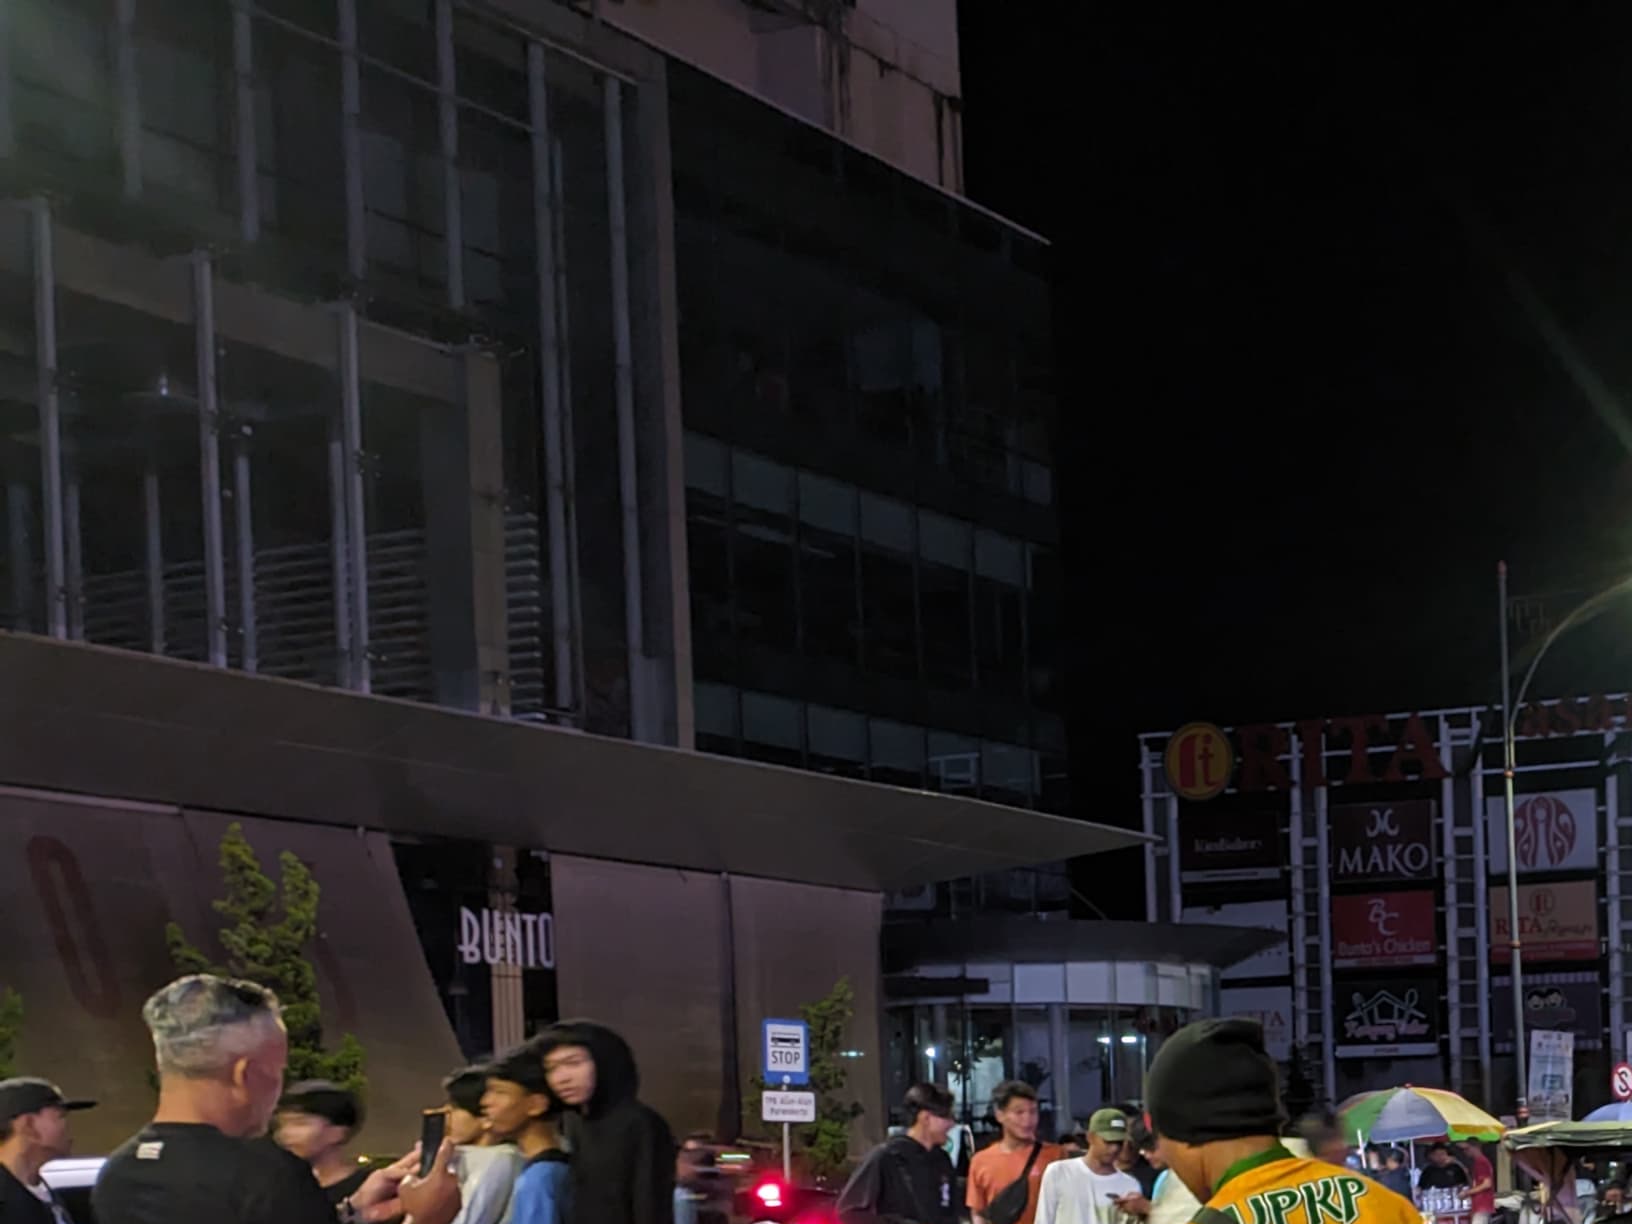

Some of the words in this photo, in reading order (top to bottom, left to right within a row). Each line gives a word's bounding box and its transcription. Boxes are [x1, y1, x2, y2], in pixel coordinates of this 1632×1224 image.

[1236, 713, 1453, 793] RITA
[1337, 842, 1430, 878] MAKO
[457, 904, 556, 970] BUNTO
[1495, 916, 1543, 936] RTA
[771, 1050, 801, 1065] STOP
